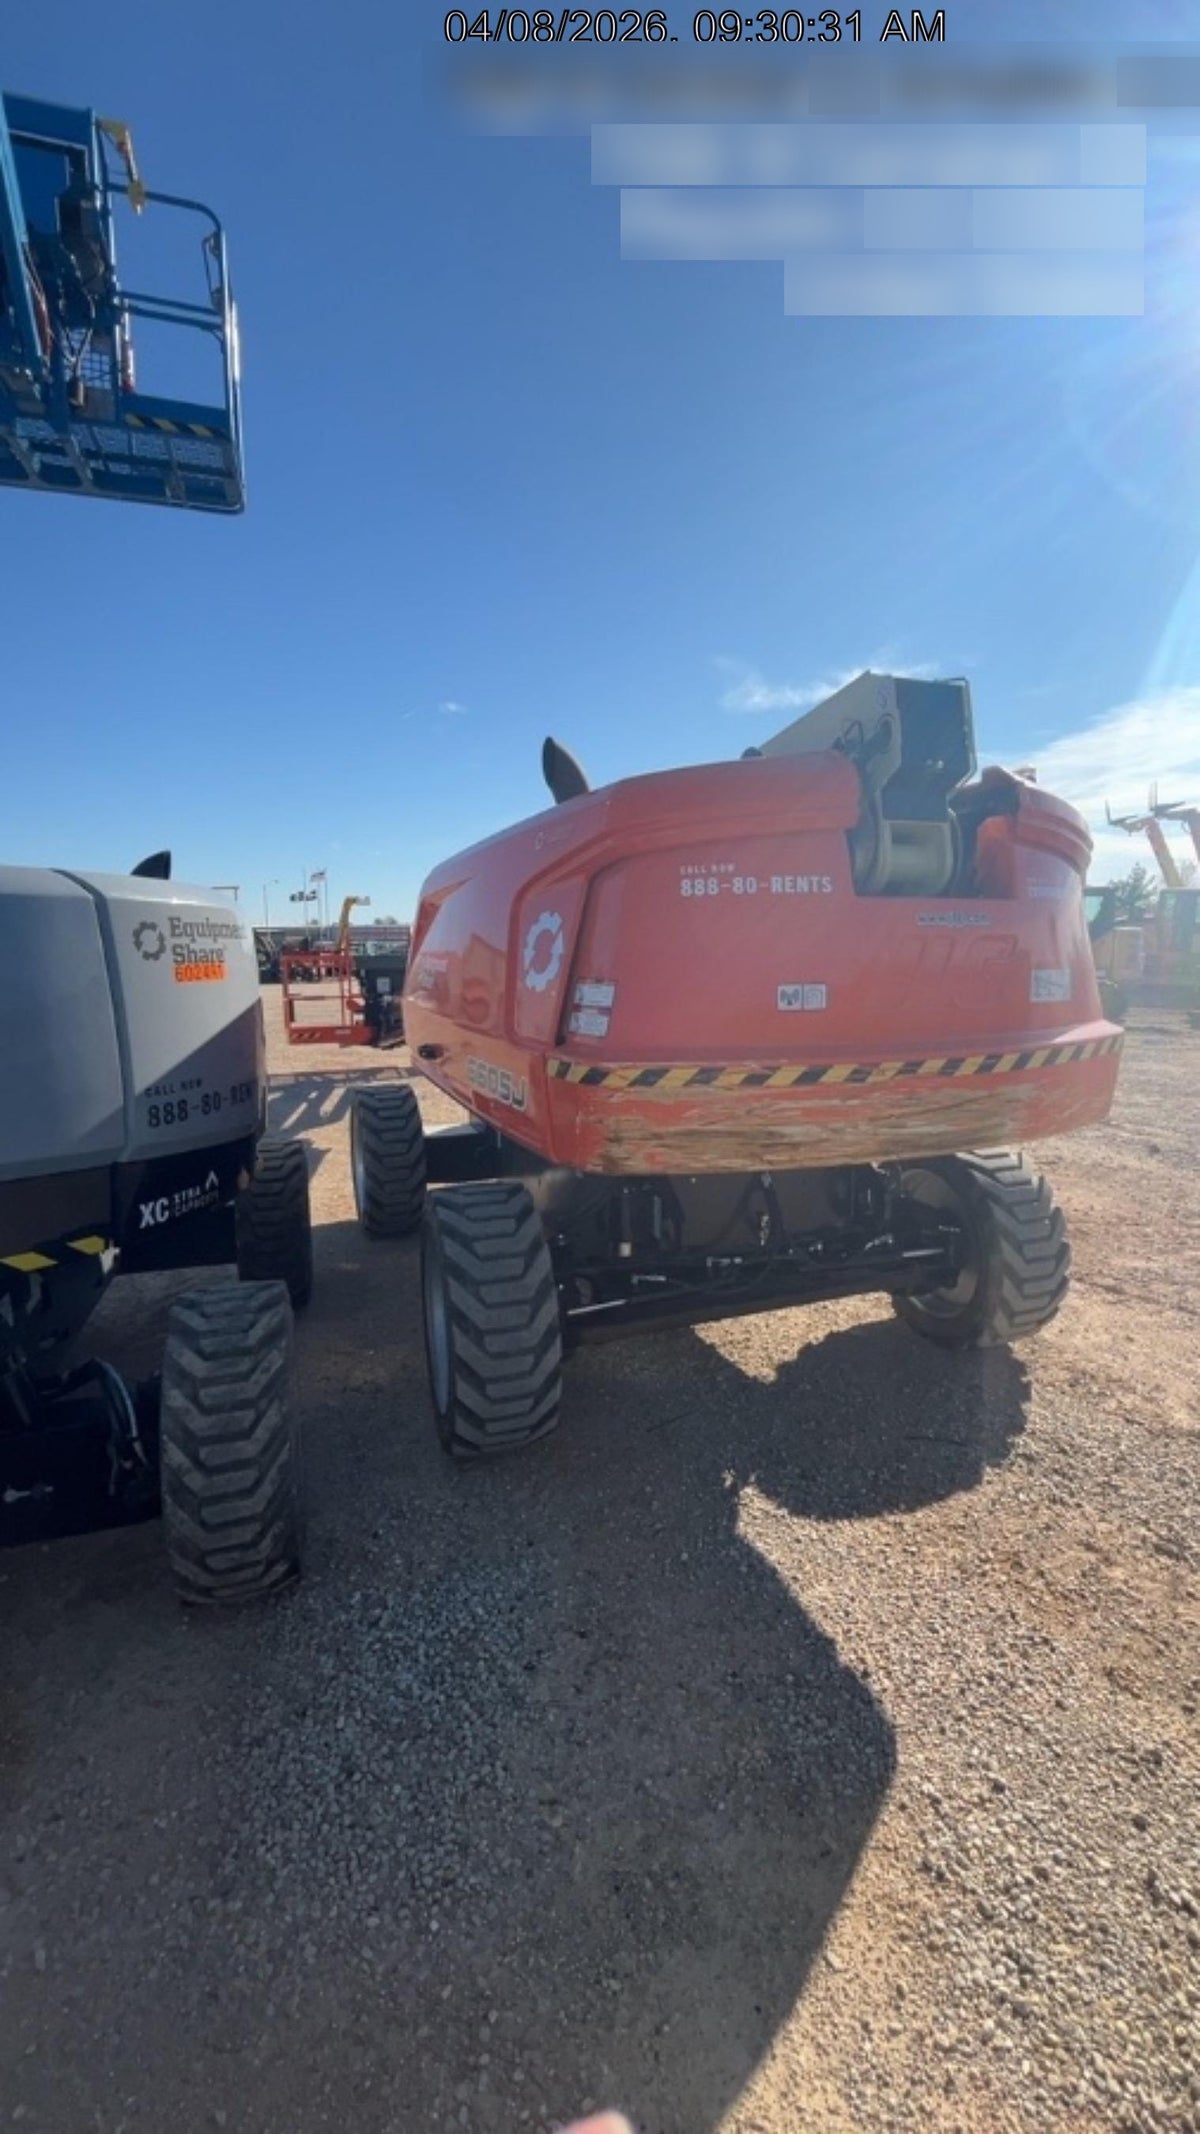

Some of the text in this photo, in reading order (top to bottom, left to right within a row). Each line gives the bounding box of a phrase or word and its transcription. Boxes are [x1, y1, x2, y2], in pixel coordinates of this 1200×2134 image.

[680, 875, 833, 897] 888-80-RENTS
[172, 943, 225, 964] Share
[139, 1196, 170, 1229] XC
